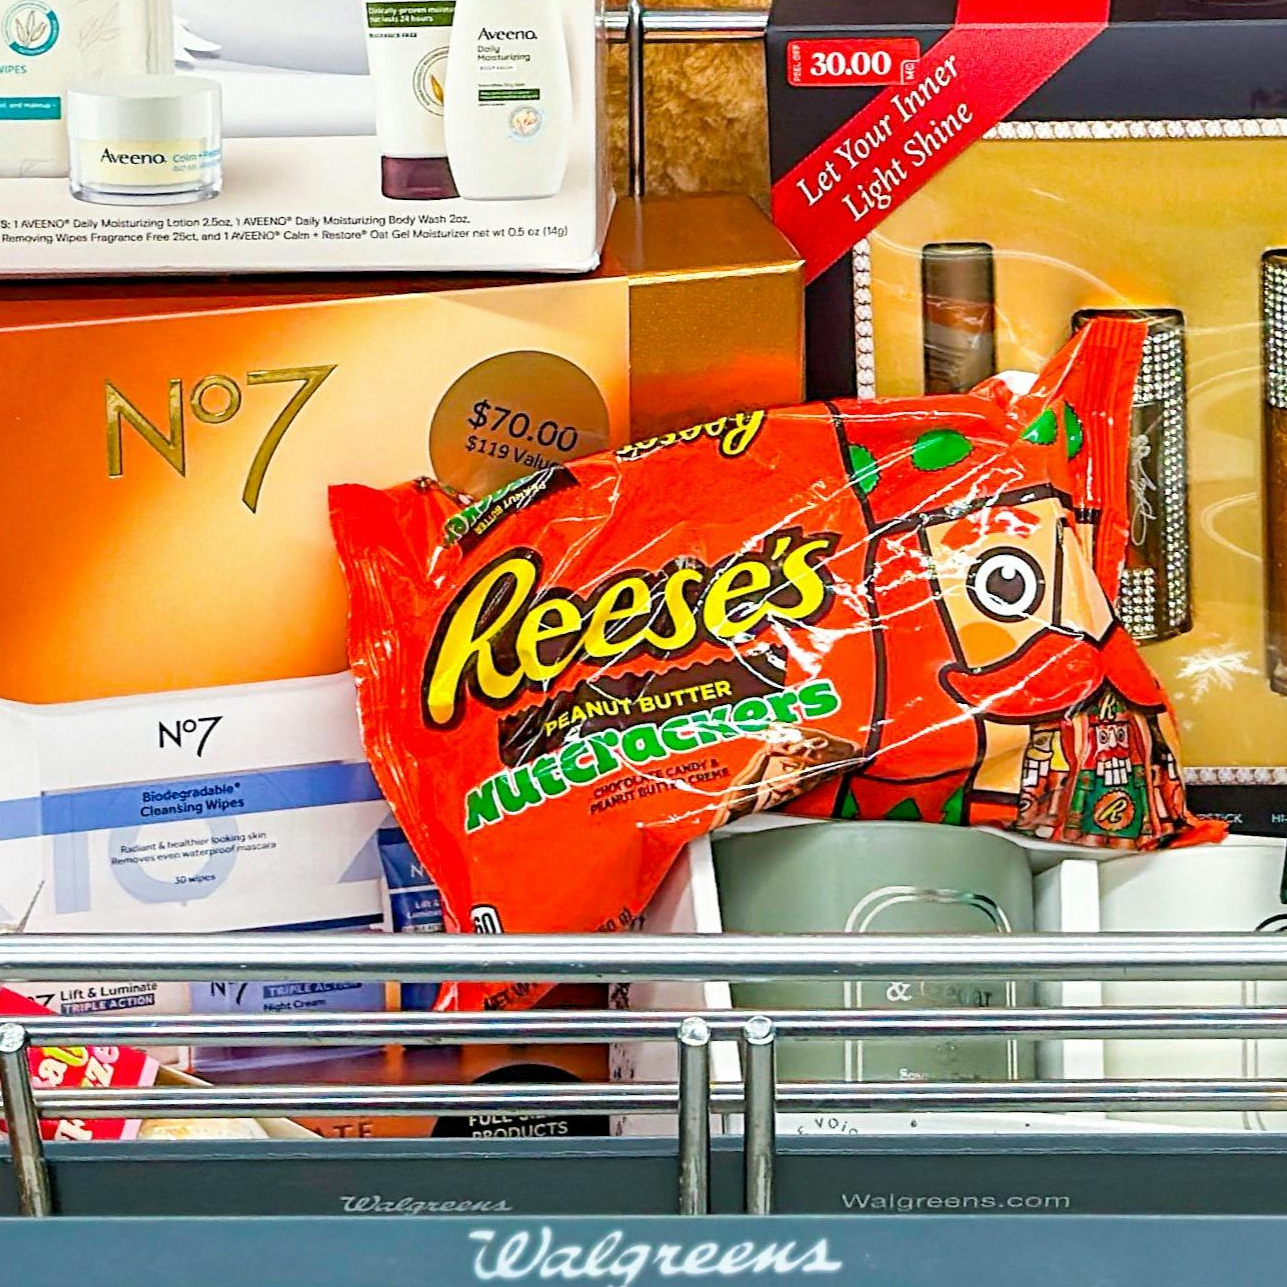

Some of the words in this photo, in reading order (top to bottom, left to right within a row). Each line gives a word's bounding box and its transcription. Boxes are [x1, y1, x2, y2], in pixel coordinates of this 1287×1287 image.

[477, 45, 501, 54] Daily
[809, 50, 892, 77] 30.00
[796, 167, 841, 207] Let
[833, 115, 892, 170] Your
[890, 54, 959, 124] Inner
[841, 158, 908, 223] Light
[903, 101, 974, 168] Shine
[73, 218, 98, 229] Daily
[167, 217, 200, 228] Lotion
[296, 216, 320, 227] Daily
[324, 215, 386, 227] Moisturizing
[389, 215, 415, 225] Body
[418, 214, 446, 224] Wash
[2, 234, 53, 245] Removing
[56, 233, 88, 244] Wipes
[91, 233, 143, 244] Fragrance
[146, 232, 170, 242] Free
[202, 231, 221, 241] and
[284, 230, 310, 240] Calm
[370, 230, 388, 239] Oat
[392, 229, 410, 239] Gel
[413, 228, 469, 239] Moisturizer
[473, 228, 490, 238] net
[492, 228, 505, 237] wt
[528, 228, 540, 236] oz
[468, 399, 578, 452] $70.00
[465, 435, 509, 459] $119
[428, 537, 832, 725] Reese's
[545, 697, 633, 736] PEANUT
[638, 679, 733, 713] BUTTER
[666, 759, 707, 777] CANDY
[688, 767, 730, 785] CREME
[141, 799, 203, 817] Cleansing
[206, 796, 245, 811] Wipes
[121, 844, 157, 854] Radiant
[211, 833, 246, 845] looking
[248, 831, 267, 841] skin
[182, 843, 237, 860] waterproof
[237, 842, 276, 852] mascara
[60, 989, 85, 1002] Lift
[88, 987, 96, 999] &
[100, 981, 159, 997] Luminate
[112, 995, 153, 1009] ACTION
[341, 1195, 513, 1213] Walgreens
[842, 1192, 1071, 1212] Walgreens.com
[467, 1228, 844, 1287] Walgreens
